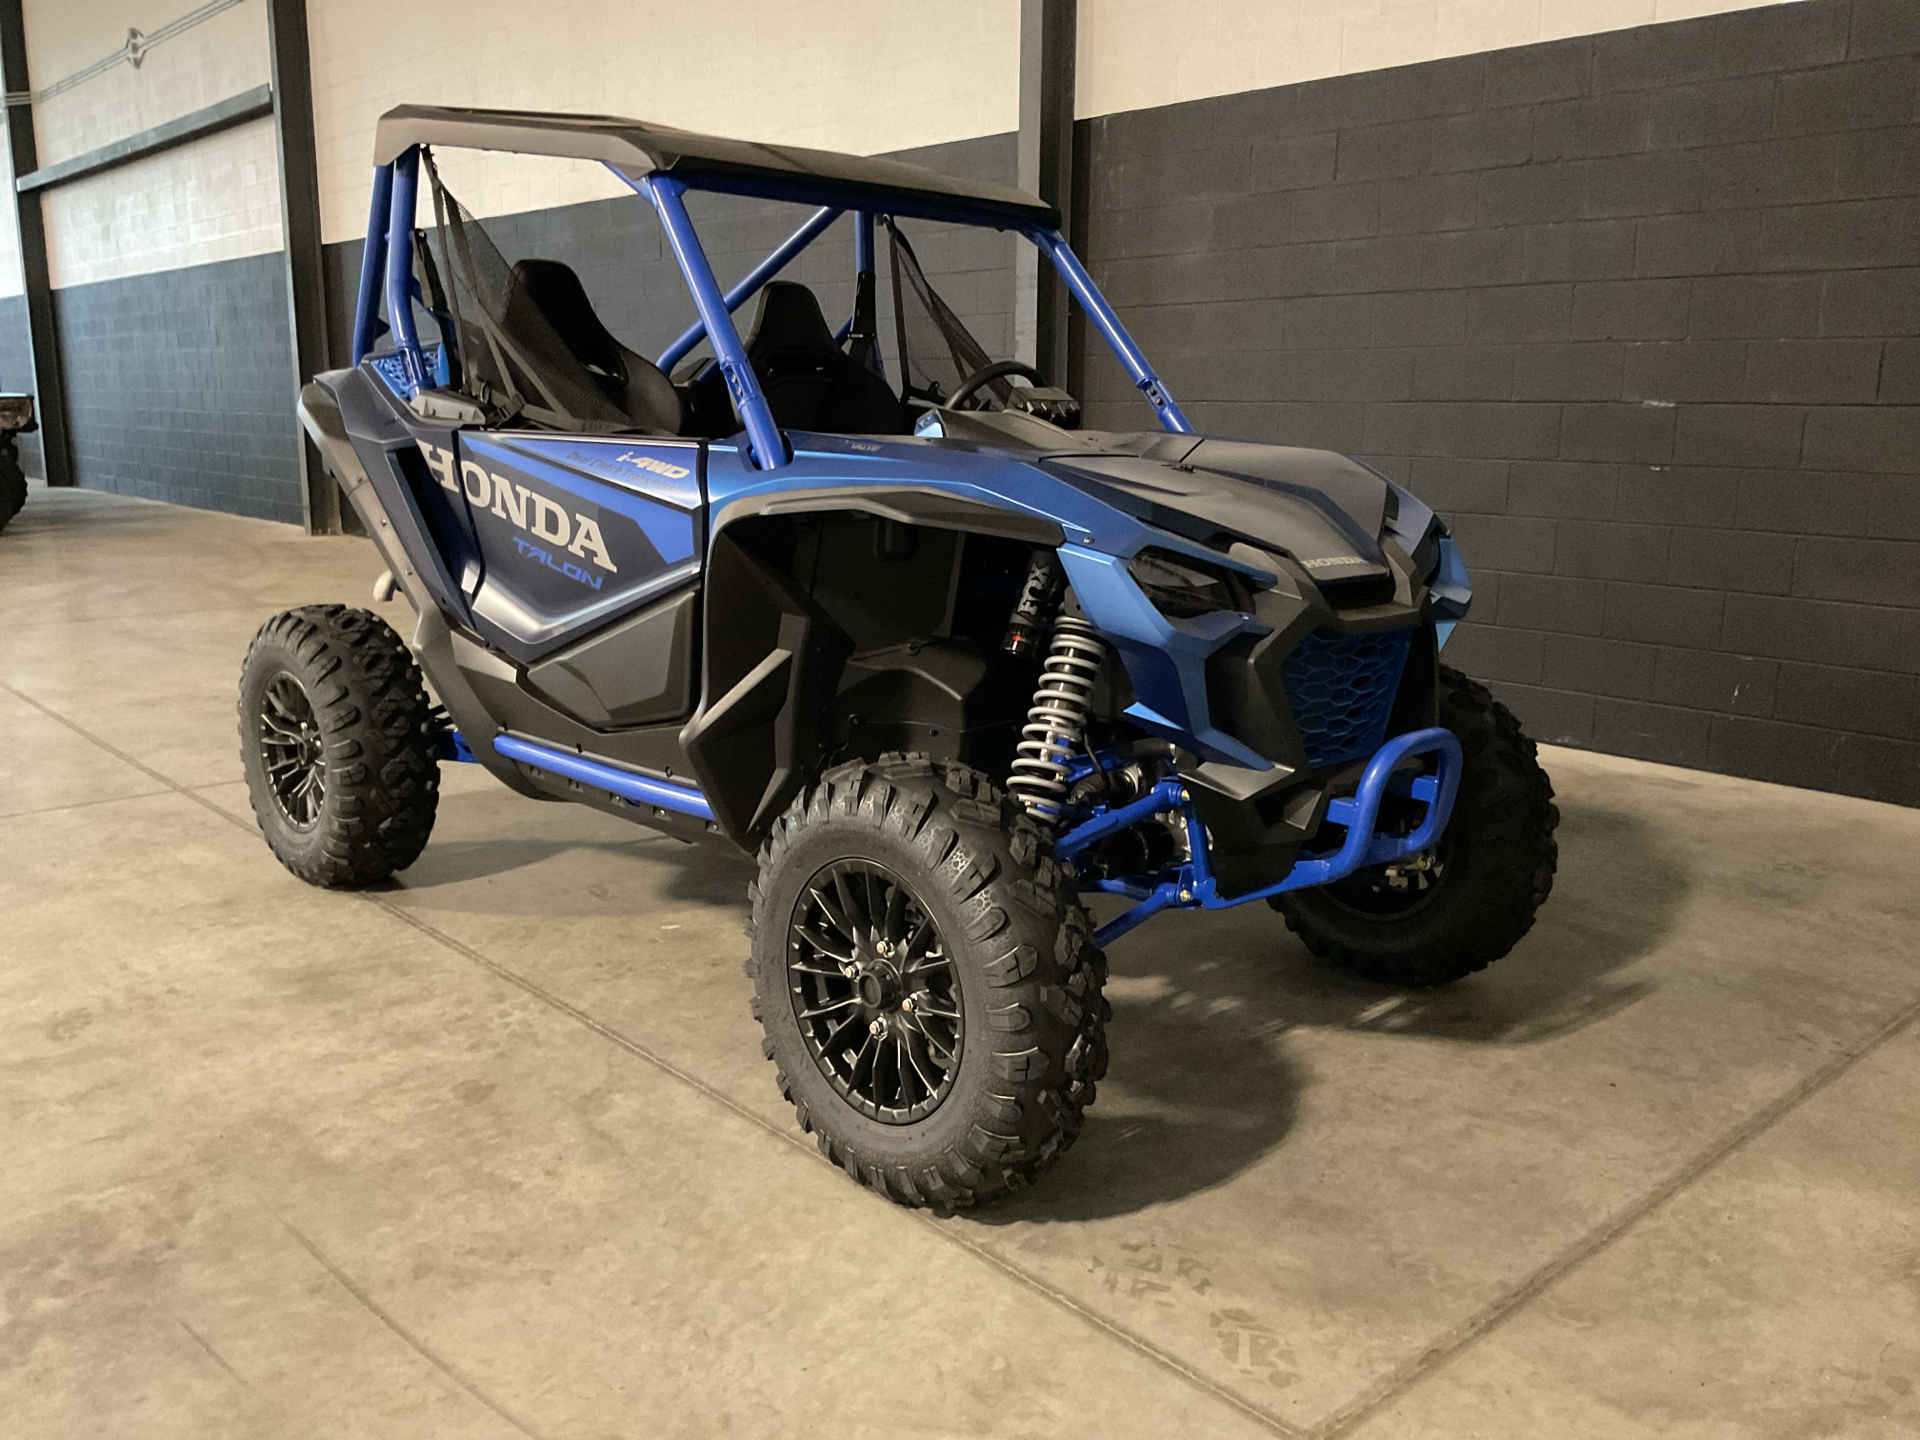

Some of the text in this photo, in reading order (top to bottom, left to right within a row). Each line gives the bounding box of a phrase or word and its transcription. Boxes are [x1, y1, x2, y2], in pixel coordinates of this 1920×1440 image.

[616, 451, 690, 479] i-4WD
[415, 438, 617, 573] HONDA
[513, 537, 603, 590] TALON
[1301, 556, 1369, 569] HONDA
